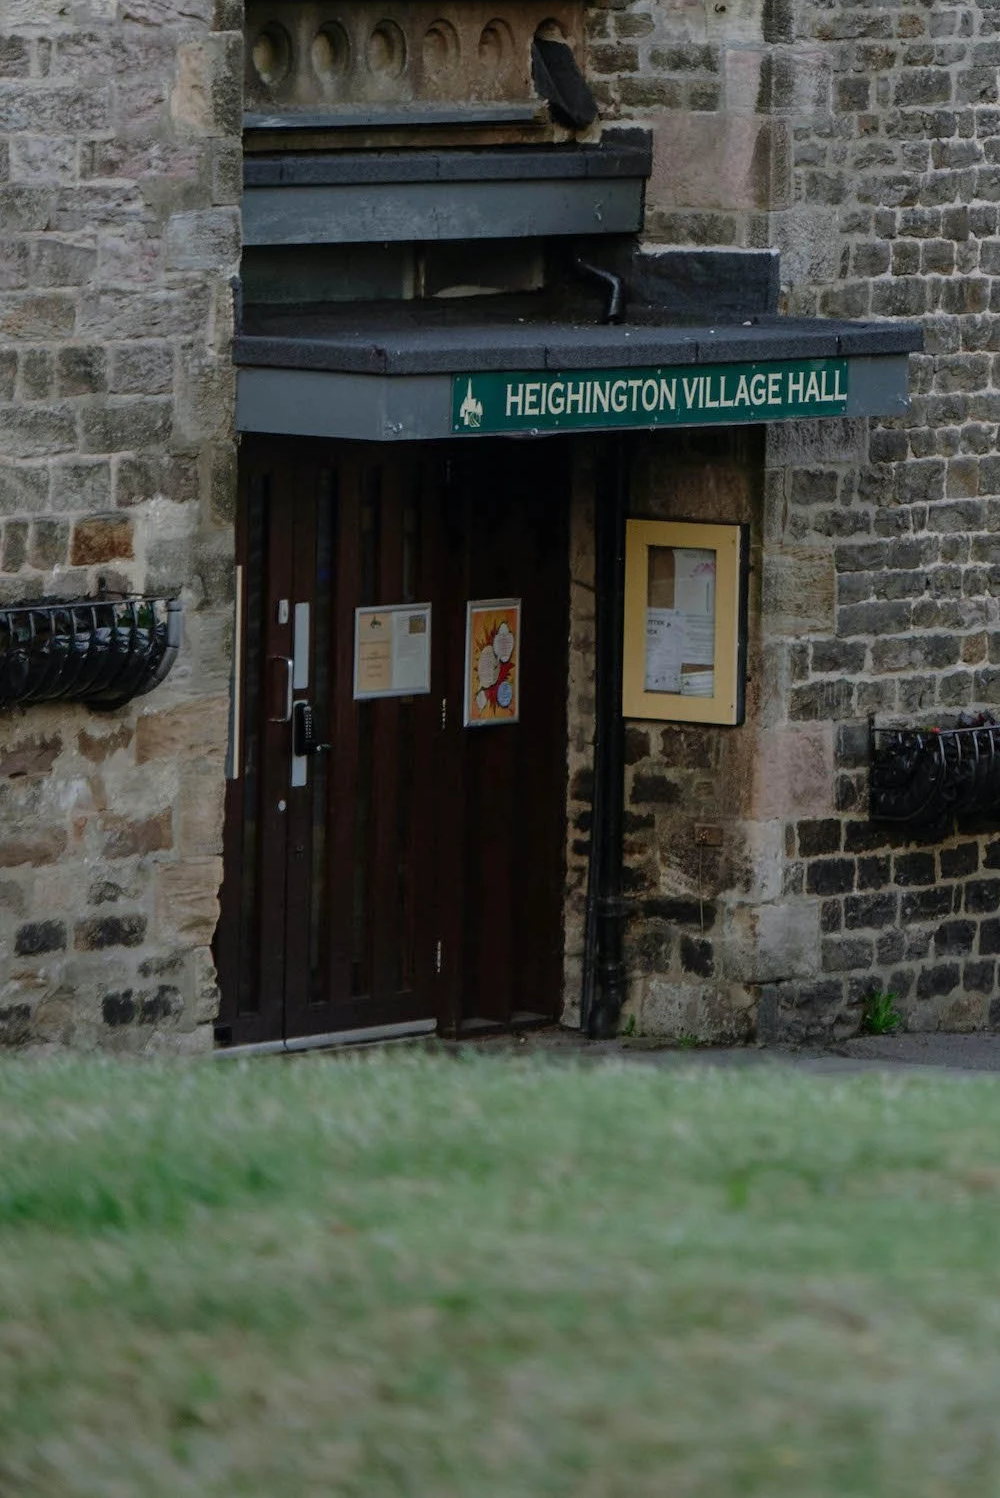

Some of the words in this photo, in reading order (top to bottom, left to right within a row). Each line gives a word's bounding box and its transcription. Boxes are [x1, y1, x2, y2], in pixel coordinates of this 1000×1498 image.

[505, 378, 677, 416] HEIGHINGTON
[682, 372, 783, 409] VILLAGE
[787, 369, 848, 404] HALL
